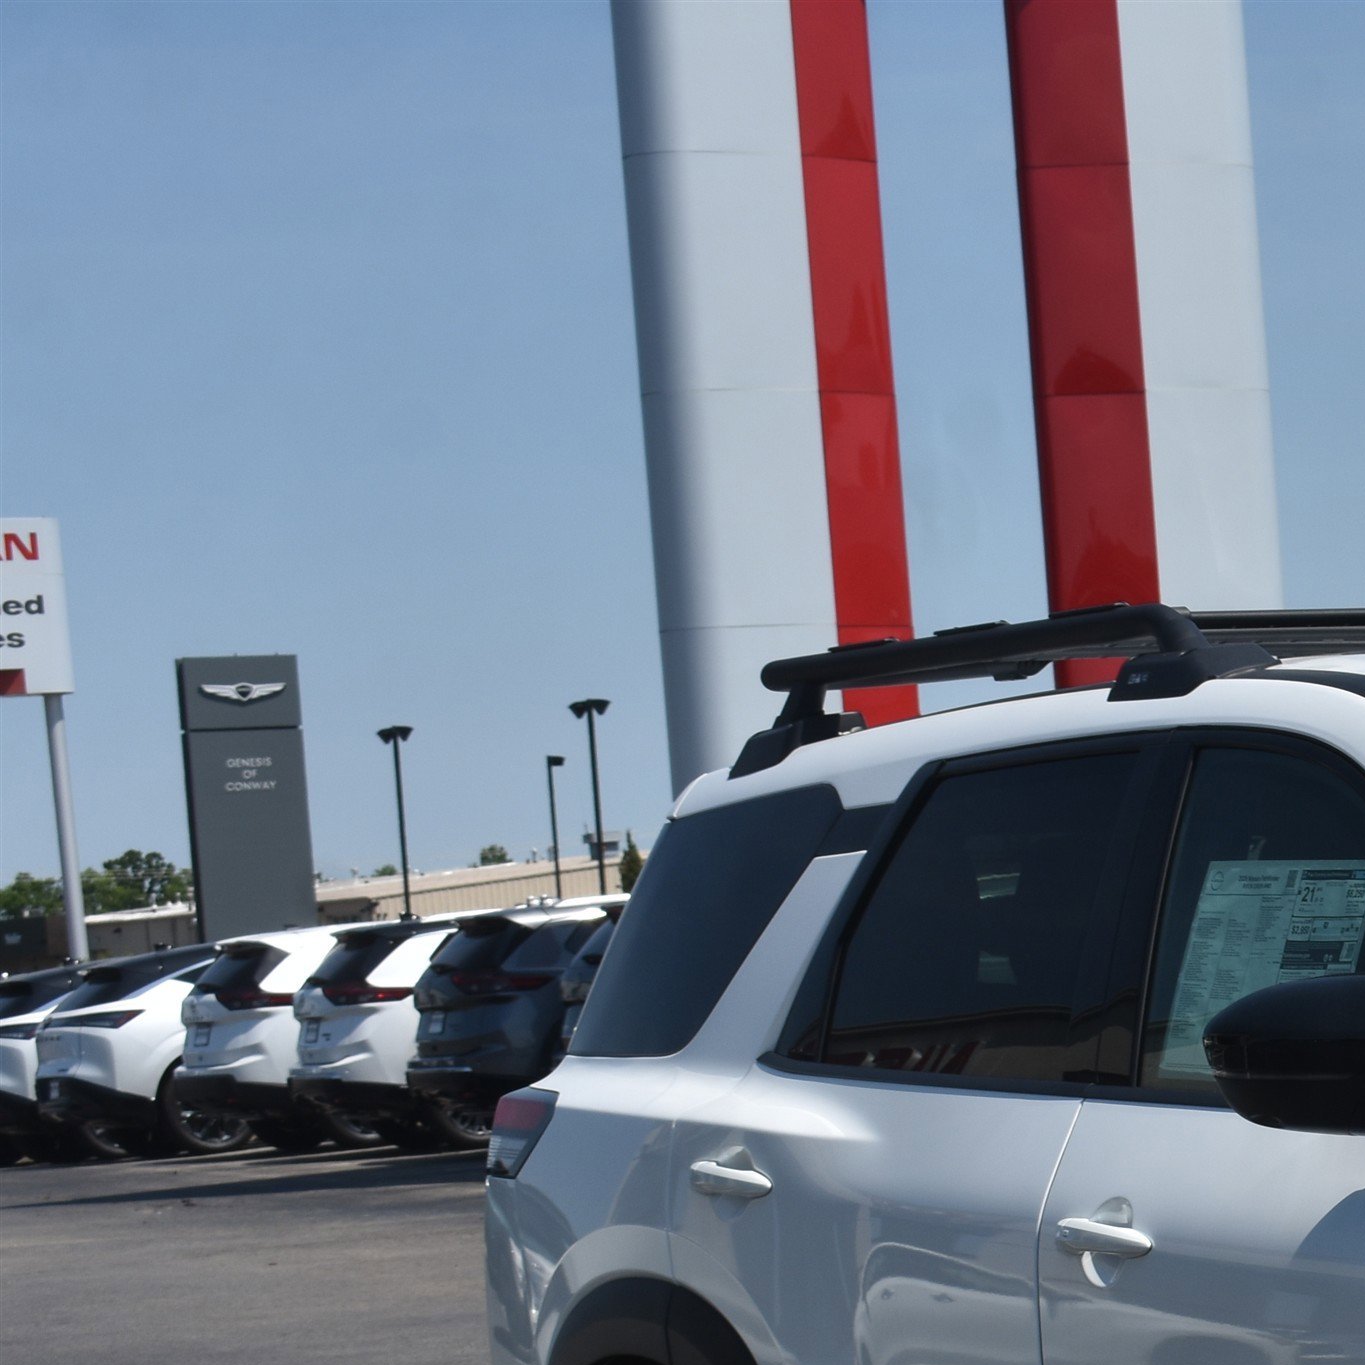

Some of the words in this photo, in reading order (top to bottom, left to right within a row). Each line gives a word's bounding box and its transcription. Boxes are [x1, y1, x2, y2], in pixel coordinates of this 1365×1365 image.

[0, 532, 39, 561] N
[0, 595, 44, 616] ed
[0, 632, 25, 648] s
[226, 756, 273, 769] GENESIS
[243, 769, 257, 779] OF
[224, 781, 277, 792] CONWAY
